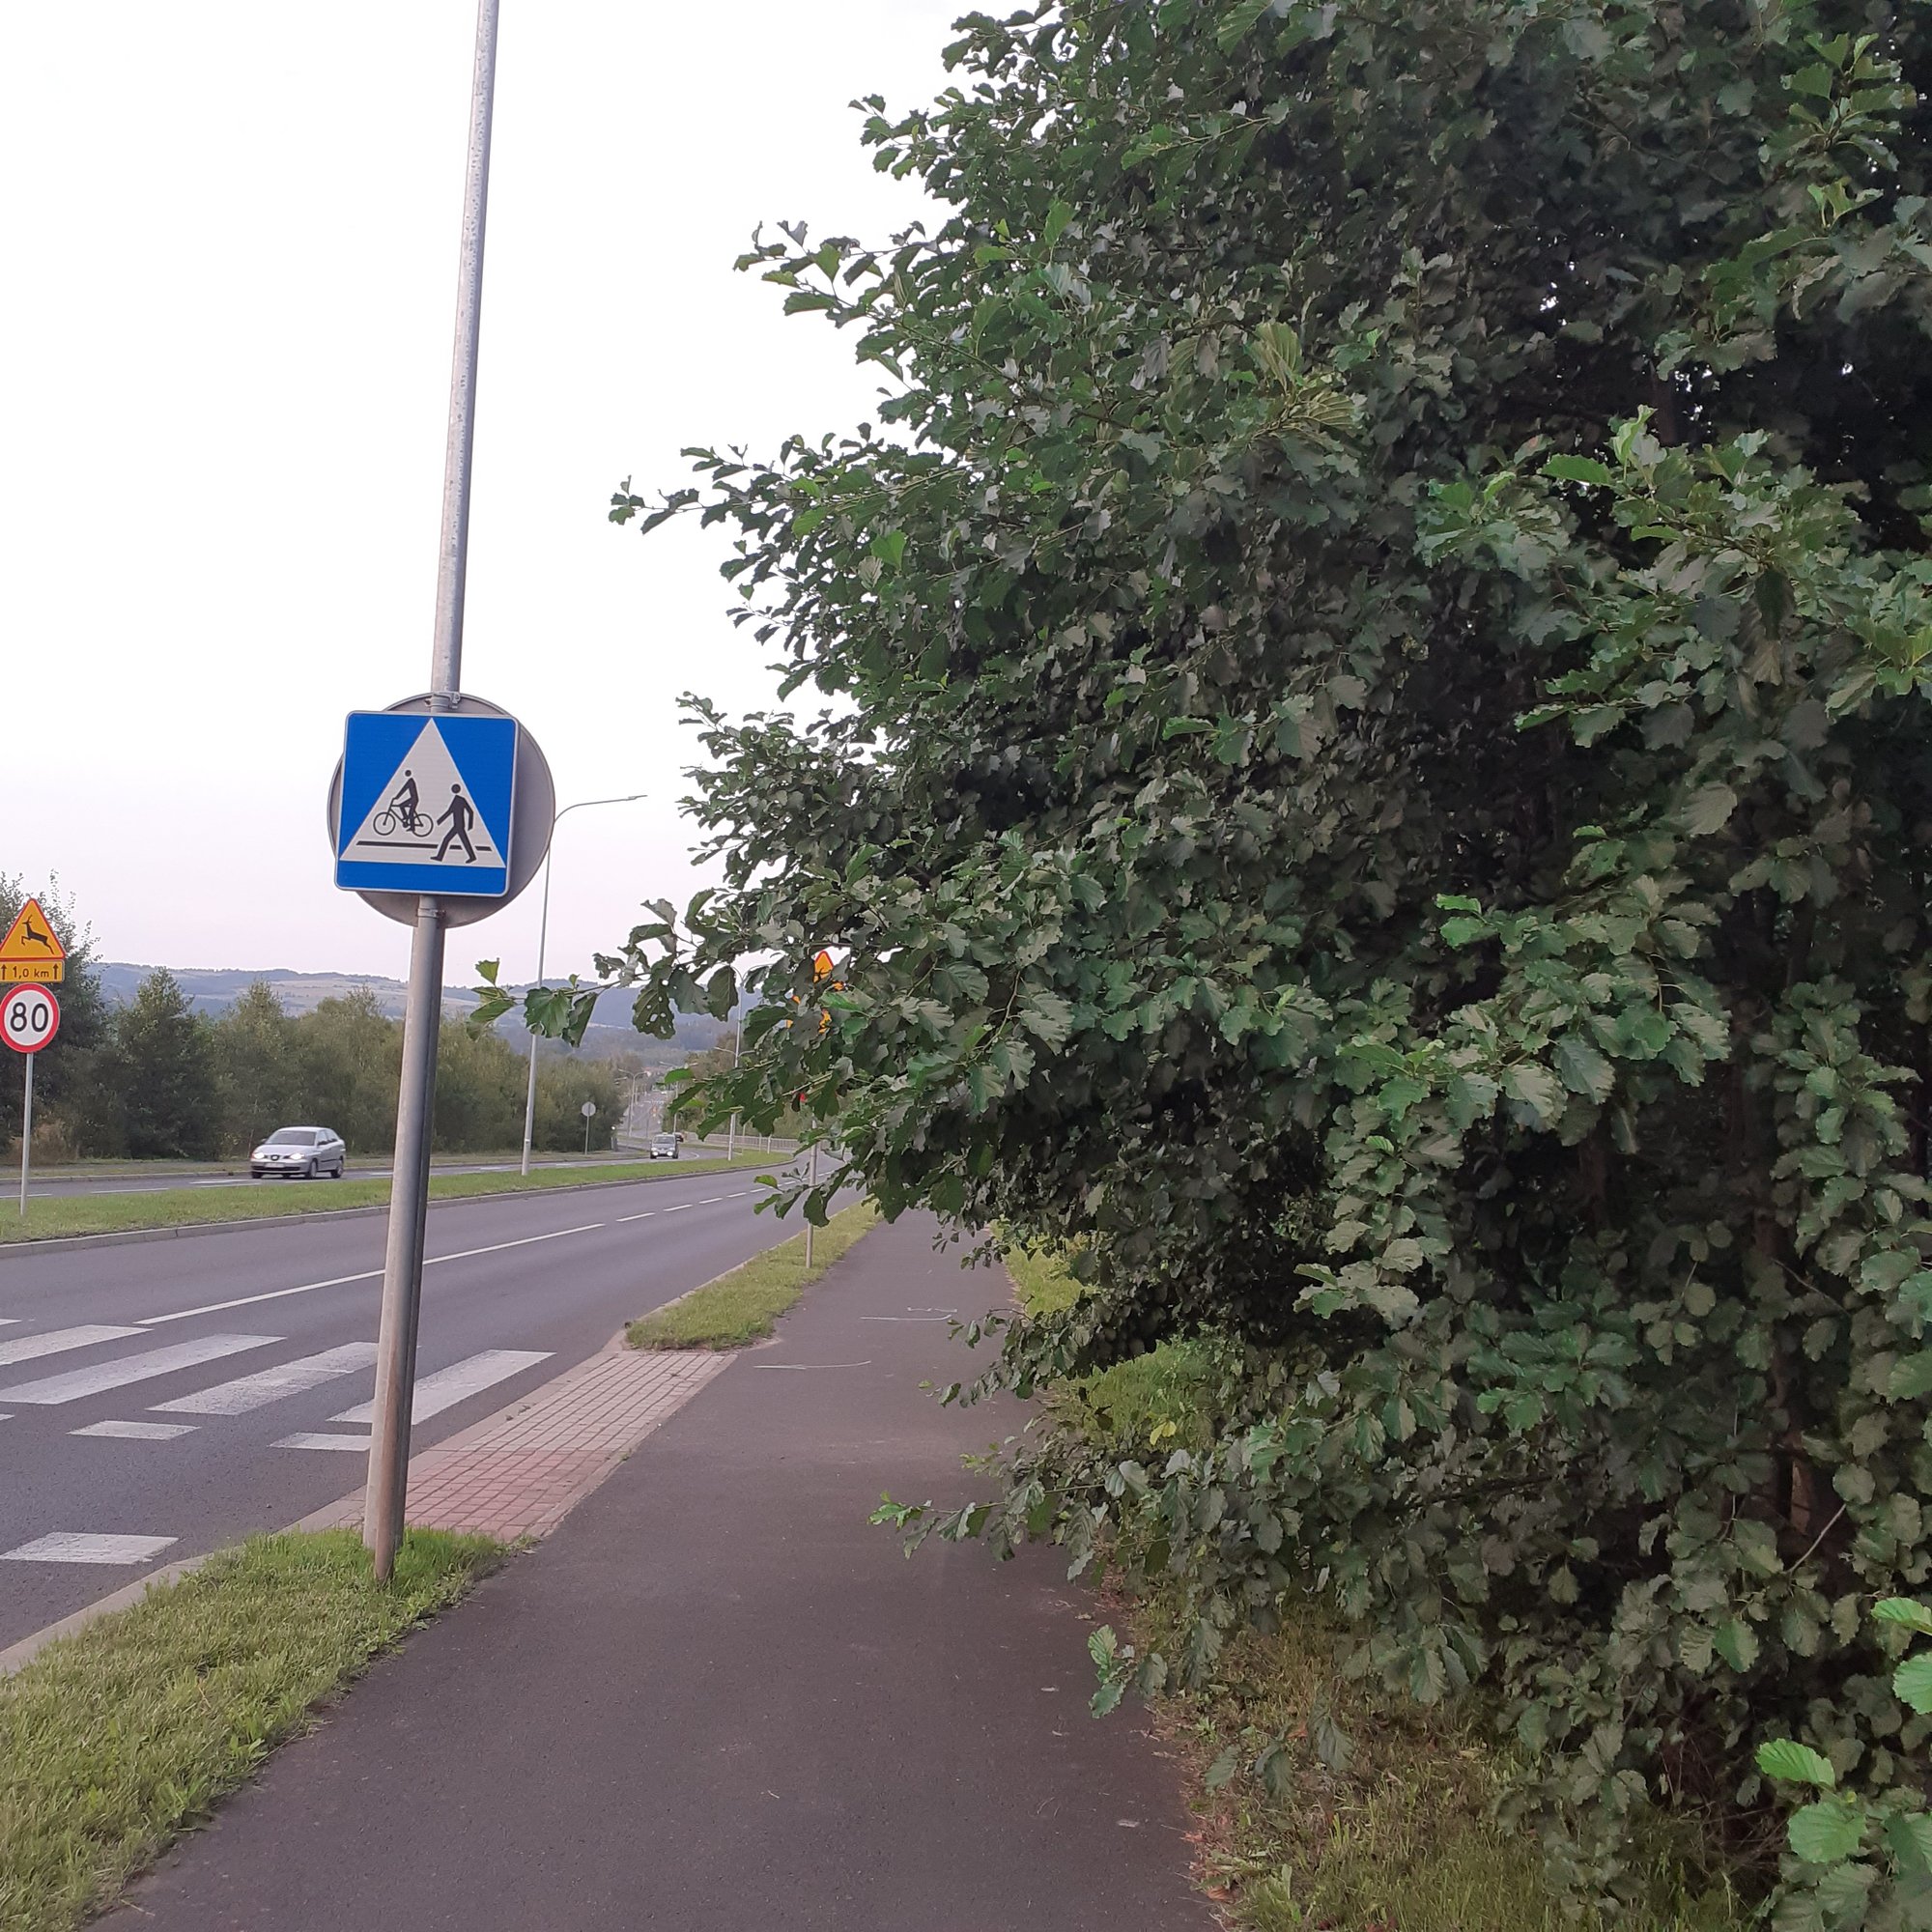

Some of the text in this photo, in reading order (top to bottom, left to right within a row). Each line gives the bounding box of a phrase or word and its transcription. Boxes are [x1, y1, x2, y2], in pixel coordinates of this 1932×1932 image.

[13, 966, 49, 979] 1,0 km
[10, 1002, 49, 1033] 80
